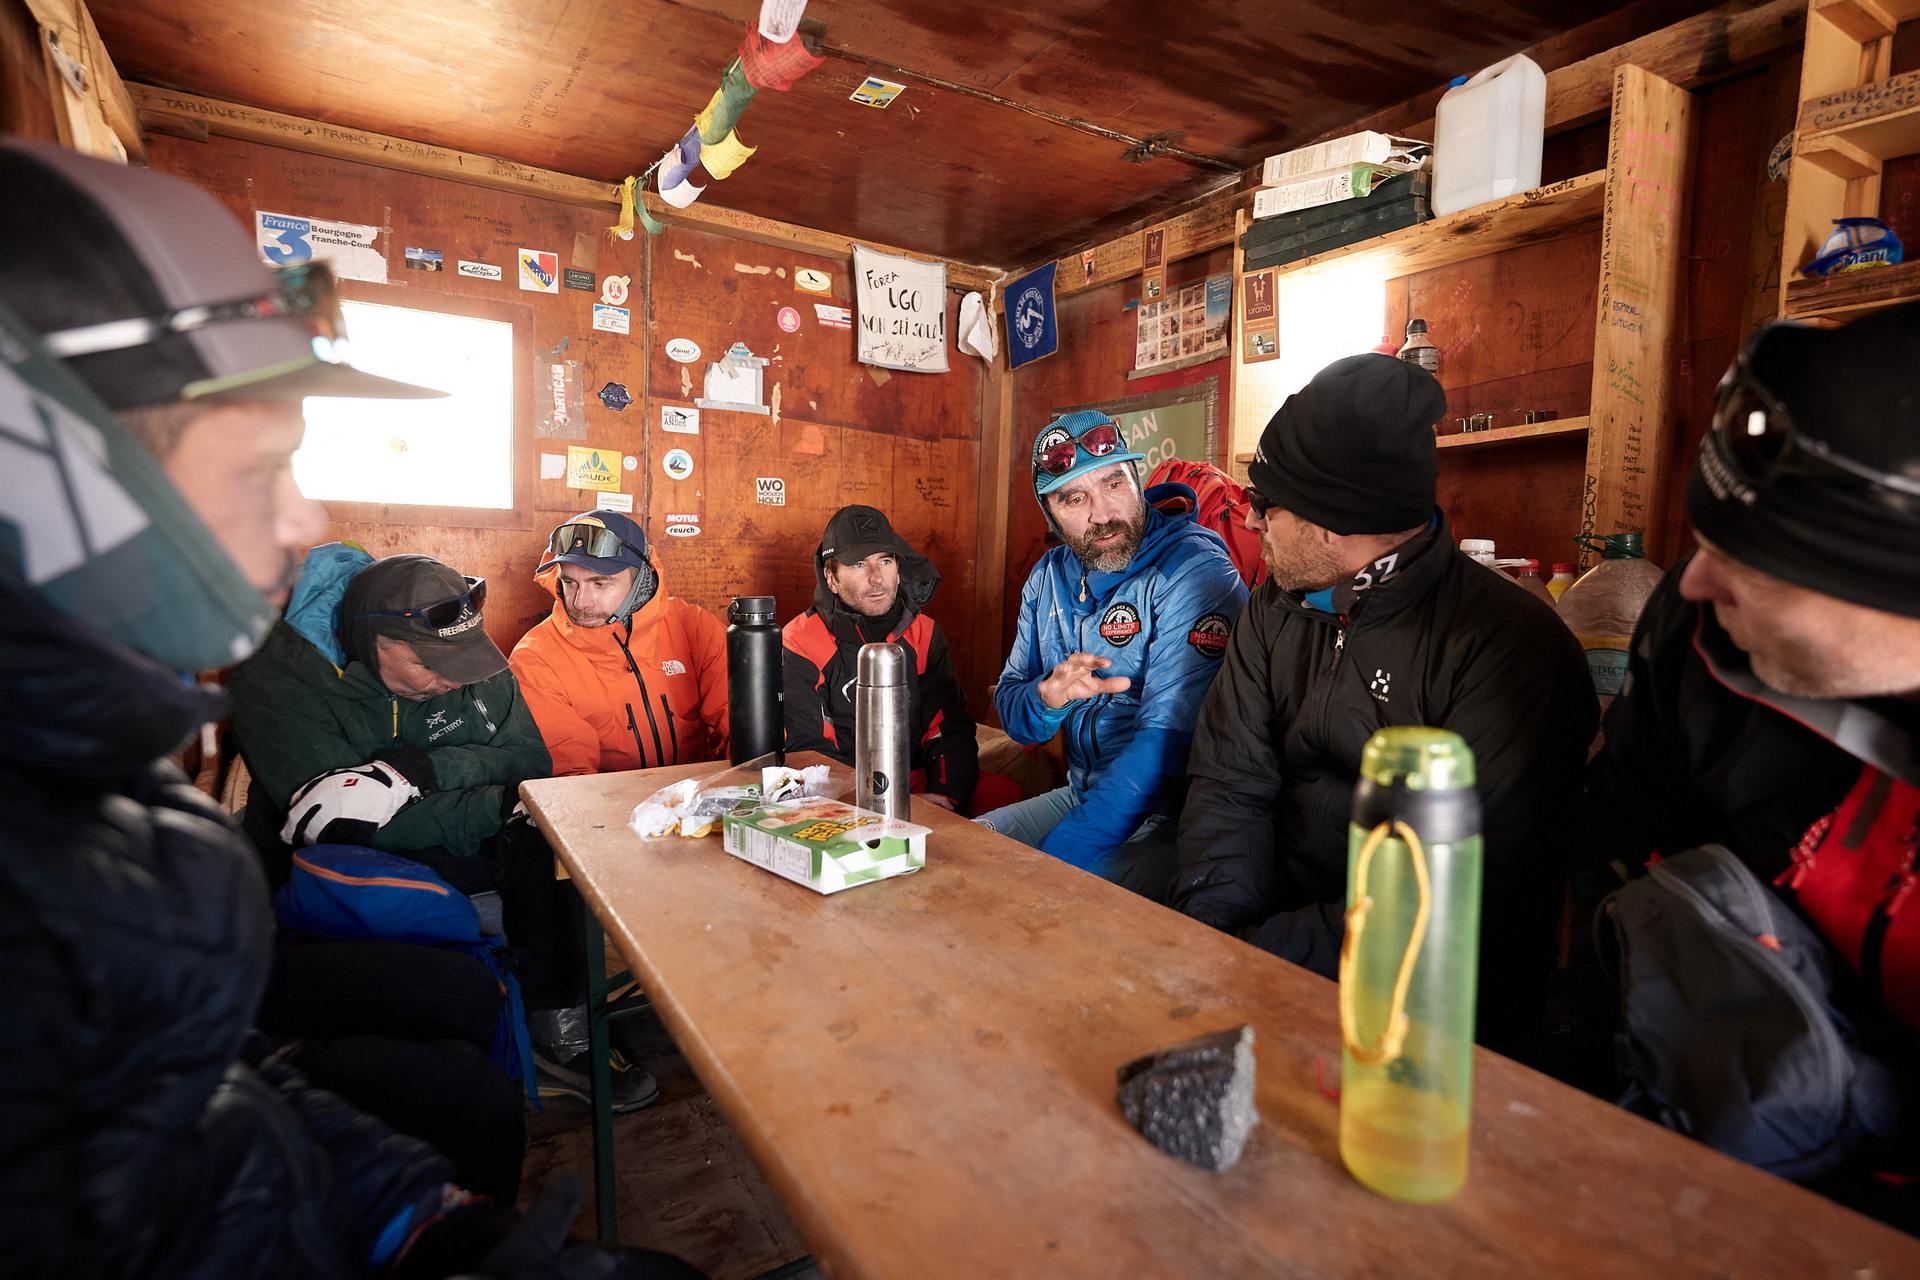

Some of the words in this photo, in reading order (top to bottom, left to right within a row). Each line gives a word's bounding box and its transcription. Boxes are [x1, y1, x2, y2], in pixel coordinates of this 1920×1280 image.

[323, 128, 373, 147] FRANCE
[264, 215, 310, 232] France
[311, 225, 363, 240] Bourgogne
[263, 229, 313, 266] 3
[889, 287, 922, 313] UGO
[1248, 304, 1271, 315] urania
[862, 314, 886, 334] NON
[758, 480, 783, 491] WO
[758, 496, 784, 504] HOLZ!
[666, 514, 700, 523] MOTUL
